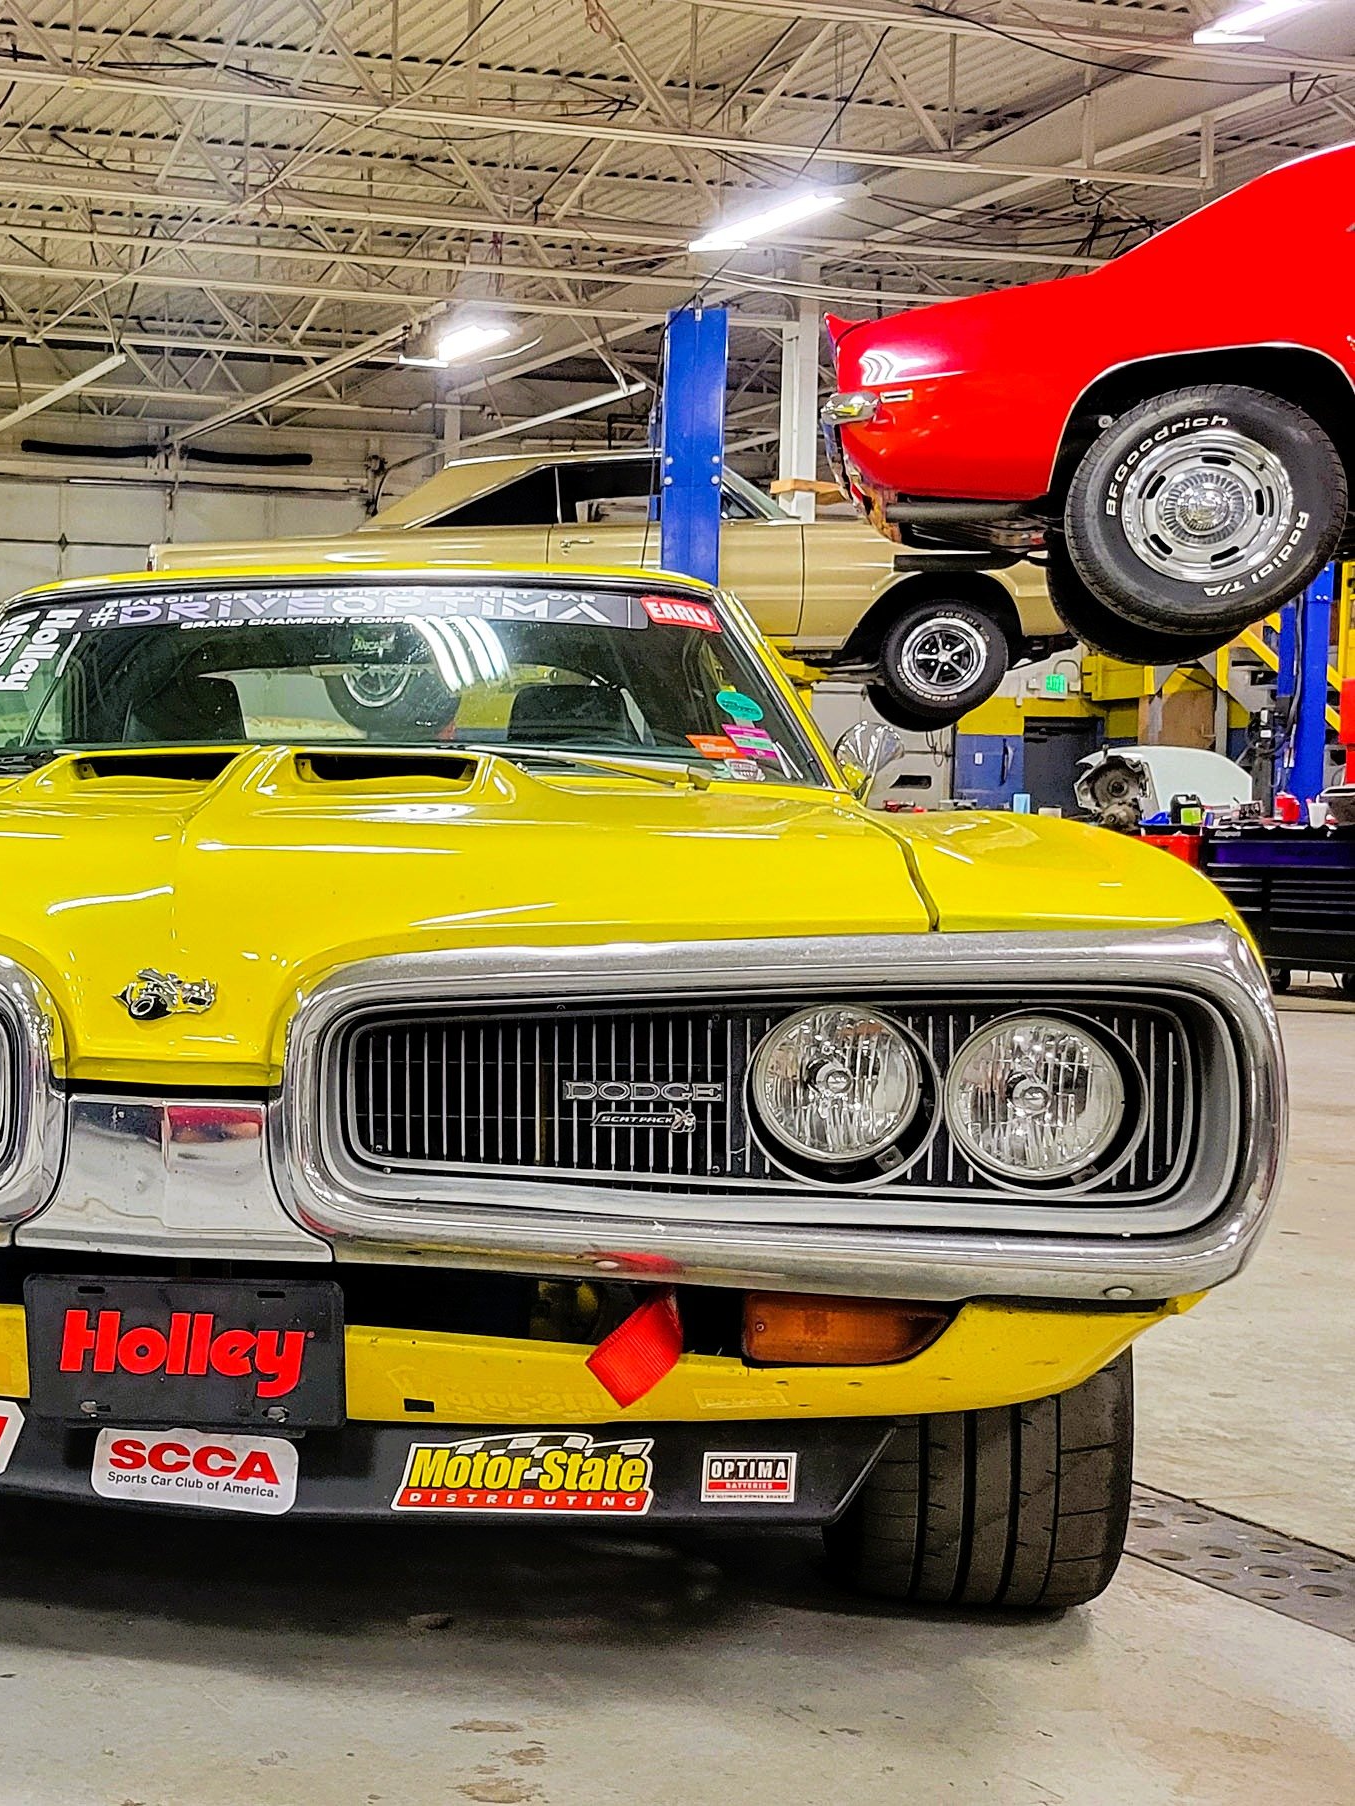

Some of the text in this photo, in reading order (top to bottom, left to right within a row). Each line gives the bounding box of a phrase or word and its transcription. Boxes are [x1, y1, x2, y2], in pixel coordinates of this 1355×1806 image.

[1105, 414, 1229, 517] BFGoodrich
[1203, 511, 1310, 597] Radial T/A
[205, 593, 248, 601] FOR
[262, 590, 304, 598] THE
[547, 593, 596, 603] CAR
[88, 596, 612, 628] #DRIVEOPTIMA
[646, 602, 714, 627] EARLY
[180, 619, 245, 630] GRAND
[248, 617, 345, 626] CHAMPION
[565, 1082, 722, 1101] DODGE
[600, 1115, 673, 1124] SCAT PACK
[60, 1309, 306, 1398] Holley
[109, 1439, 281, 1485] SCCA
[409, 1448, 646, 1493] Motor-State
[710, 1461, 787, 1479] OPTIMA
[107, 1470, 147, 1486] Sports
[150, 1474, 173, 1487] Car
[175, 1475, 203, 1490] Club
[206, 1479, 221, 1491] of
[725, 1481, 773, 1489] BATTERIES
[409, 1493, 637, 1507] DISTRIBUTING
